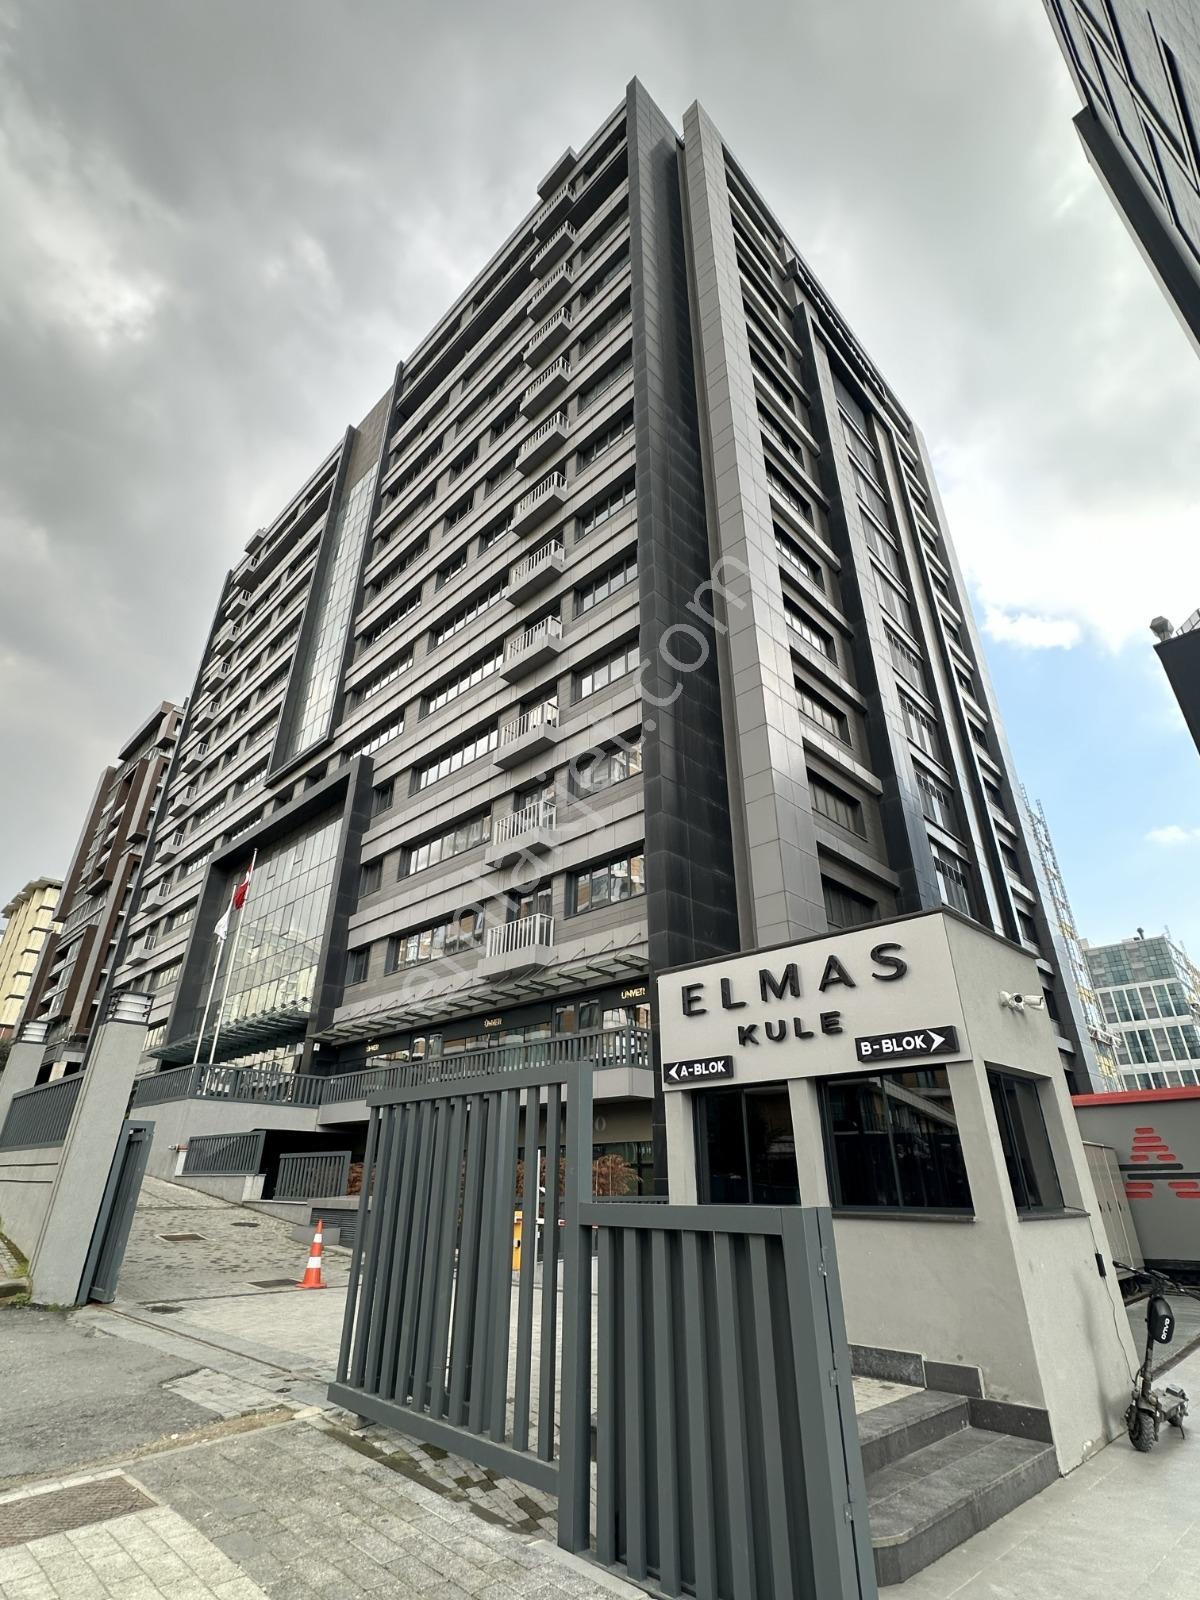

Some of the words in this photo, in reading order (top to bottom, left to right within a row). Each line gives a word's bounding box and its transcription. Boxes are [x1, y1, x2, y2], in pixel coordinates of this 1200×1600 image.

[681, 942, 908, 1017] ELMAS
[737, 1010, 844, 1047] KULE
[861, 1034, 928, 1055] B-BLOK
[680, 1060, 726, 1077] A-BLOK
